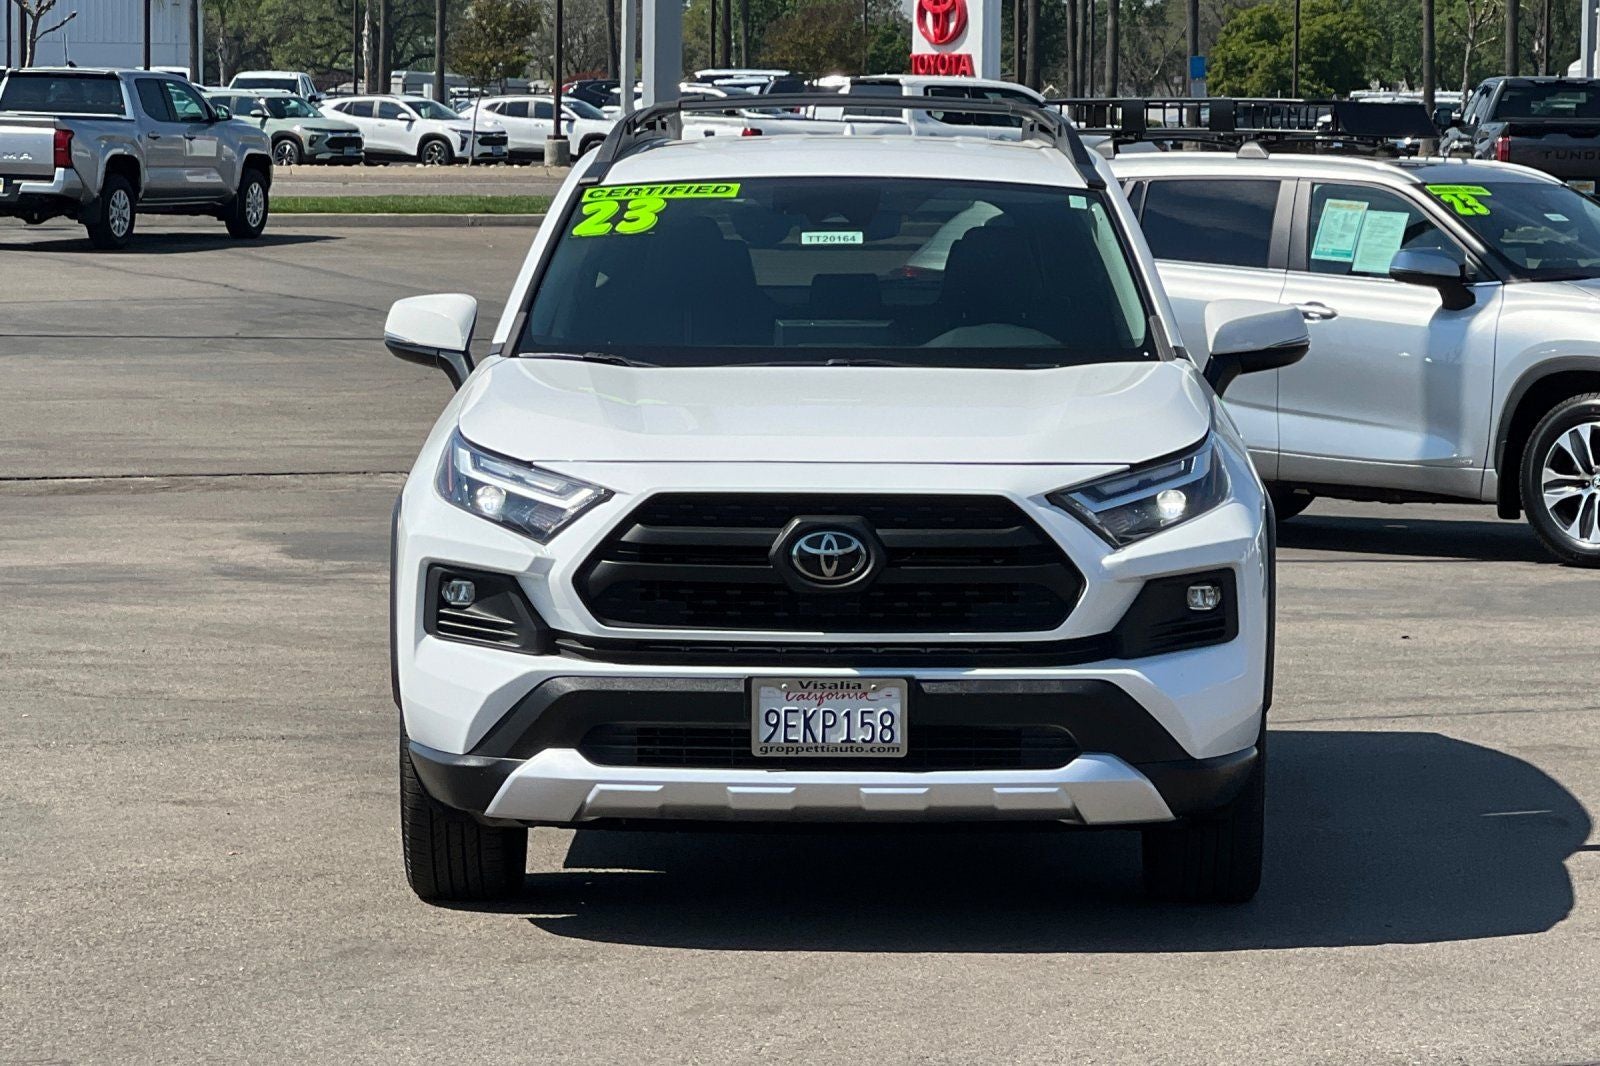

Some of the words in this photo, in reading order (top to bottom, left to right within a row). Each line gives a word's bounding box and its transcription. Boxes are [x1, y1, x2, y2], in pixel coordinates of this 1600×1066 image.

[910, 53, 975, 77] TOYOTA
[1541, 150, 1600, 160] TUND
[587, 184, 734, 199] CERTIFIED
[1440, 193, 1491, 216] 23
[571, 197, 668, 237] 23
[807, 235, 857, 243] TT20164
[798, 680, 862, 690] Visalia
[785, 690, 879, 707] California
[763, 707, 895, 743] 9EKP158
[759, 744, 900, 755] groppettiauto.com
